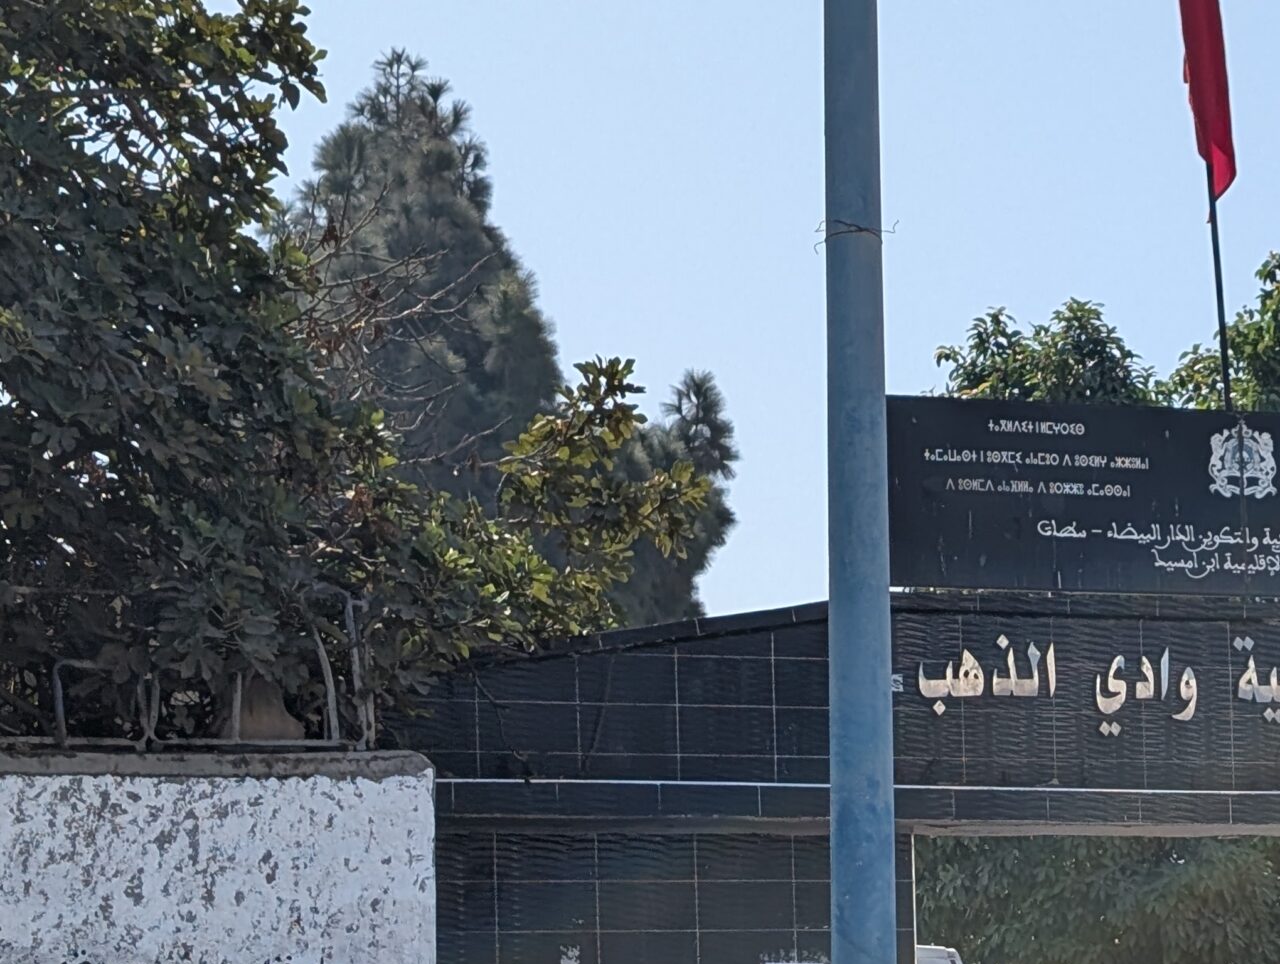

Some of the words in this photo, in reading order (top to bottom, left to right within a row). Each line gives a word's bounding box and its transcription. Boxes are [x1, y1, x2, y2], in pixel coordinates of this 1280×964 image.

[1037, 519, 1087, 539] سطات
[1107, 522, 1162, 544] البيضاء
[1154, 523, 1196, 550] الدار
[1185, 552, 1220, 579] ابن
[918, 634, 1057, 716] الذهب
[1095, 646, 1198, 736] وادي
